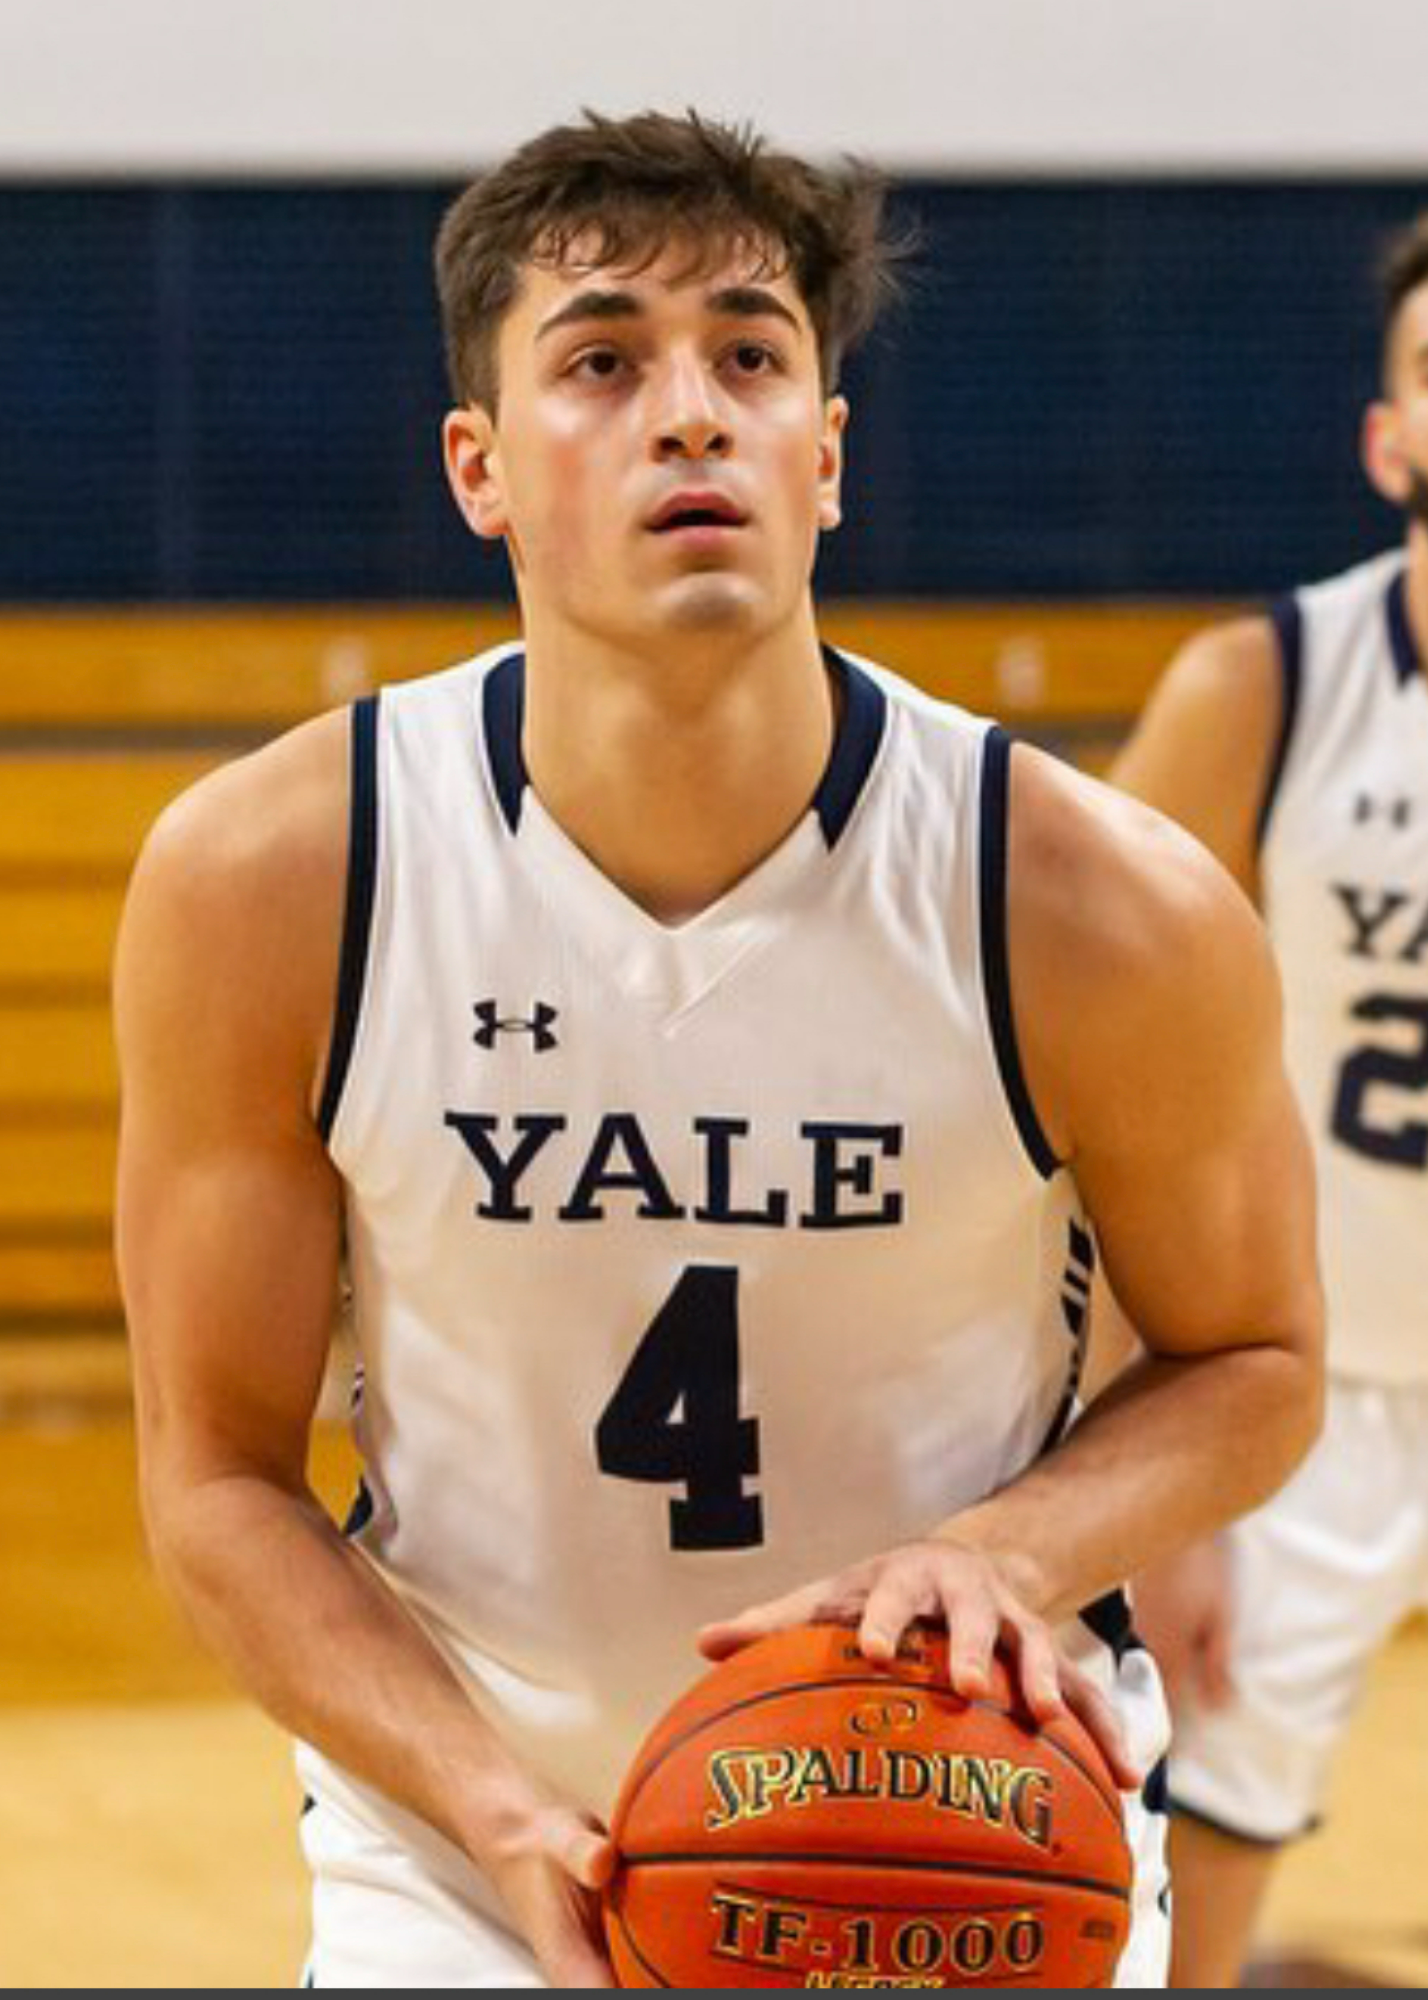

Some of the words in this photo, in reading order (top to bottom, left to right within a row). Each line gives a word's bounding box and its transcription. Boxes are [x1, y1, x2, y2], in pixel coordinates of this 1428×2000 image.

[444, 1111, 903, 1228] YALE
[594, 1264, 763, 1550] 4
[707, 1747, 1055, 1848] SPALDING
[711, 1893, 1045, 1974] TF-1000
